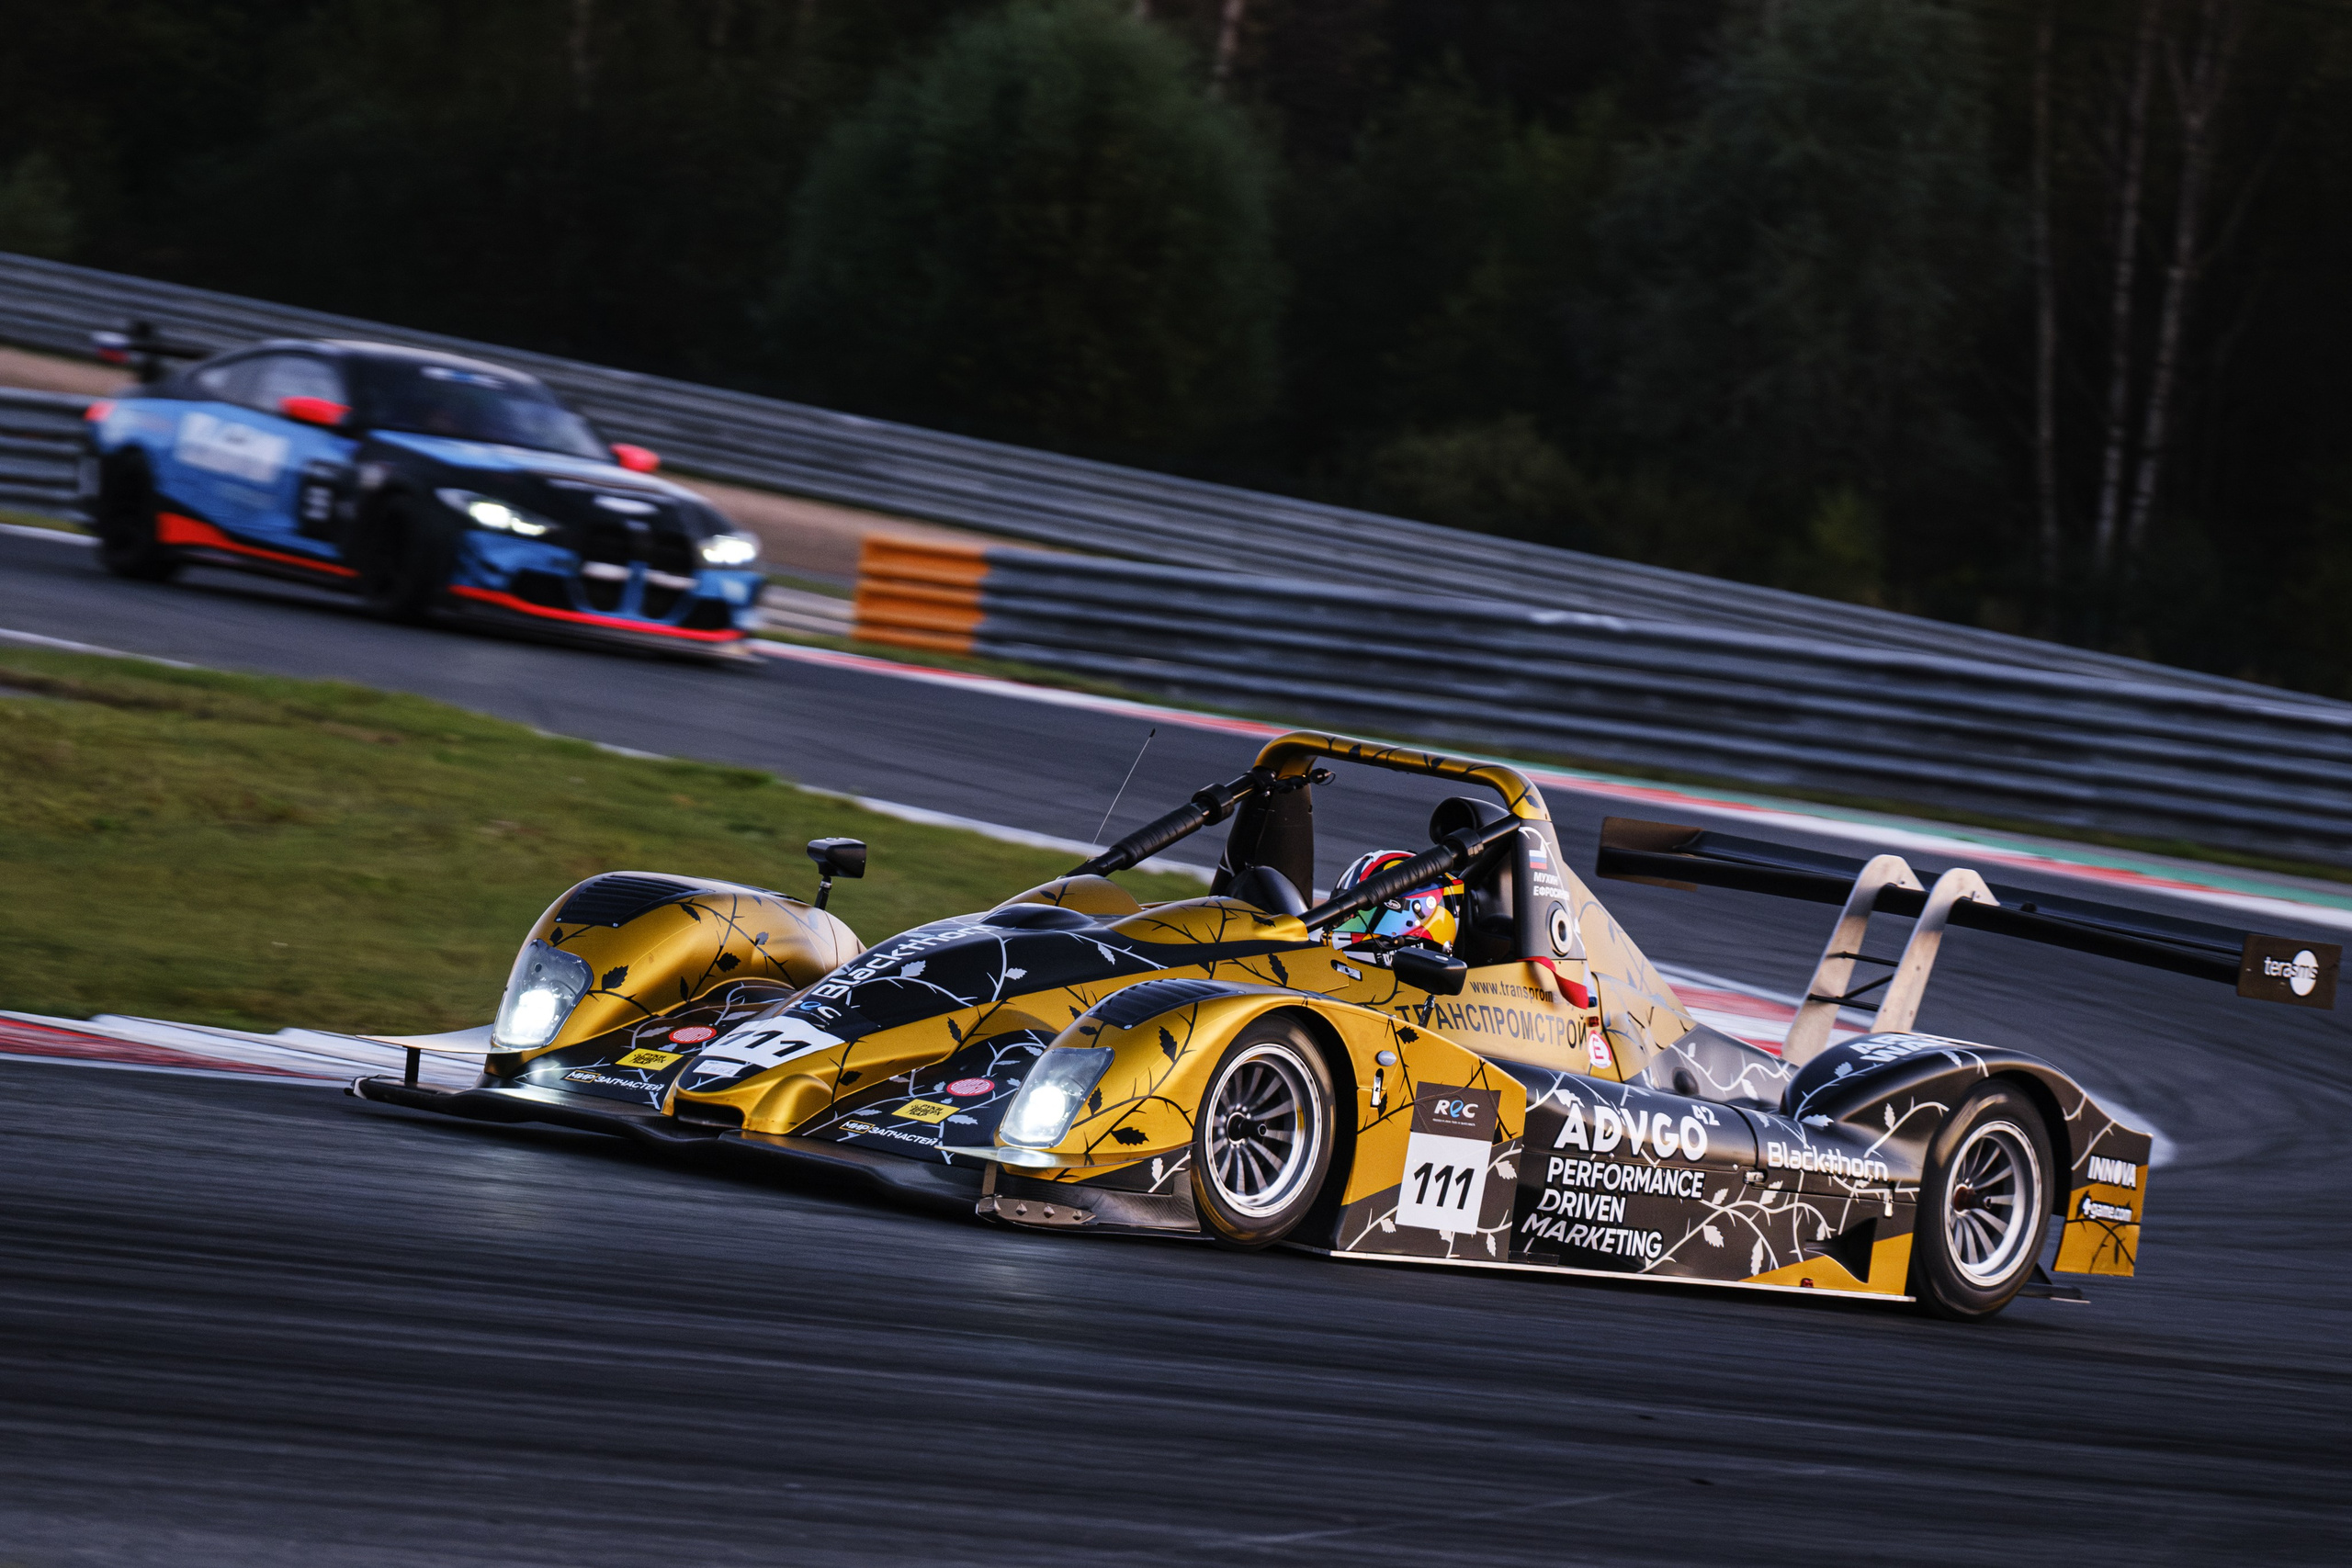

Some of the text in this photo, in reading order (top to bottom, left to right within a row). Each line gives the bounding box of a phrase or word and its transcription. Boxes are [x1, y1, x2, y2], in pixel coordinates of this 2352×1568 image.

[811, 925, 1003, 999] Blackthorn
[718, 1030, 812, 1057] 111
[567, 1070, 665, 1092] МИР ЗАПЧАСТЕЙ
[842, 1122, 939, 1145] МИР ЗАПЧАСТЕЙ
[1554, 1103, 1708, 1161] ADVGO
[1547, 1156, 1705, 1198] PERFORMANCE
[1767, 1141, 1889, 1181] Blackthorn
[2087, 1155, 2136, 1188] INNOVA
[1414, 1162, 1475, 1210] 111
[1537, 1189, 1626, 1223] DRIVEN
[1521, 1213, 1663, 1258] MARKETING
